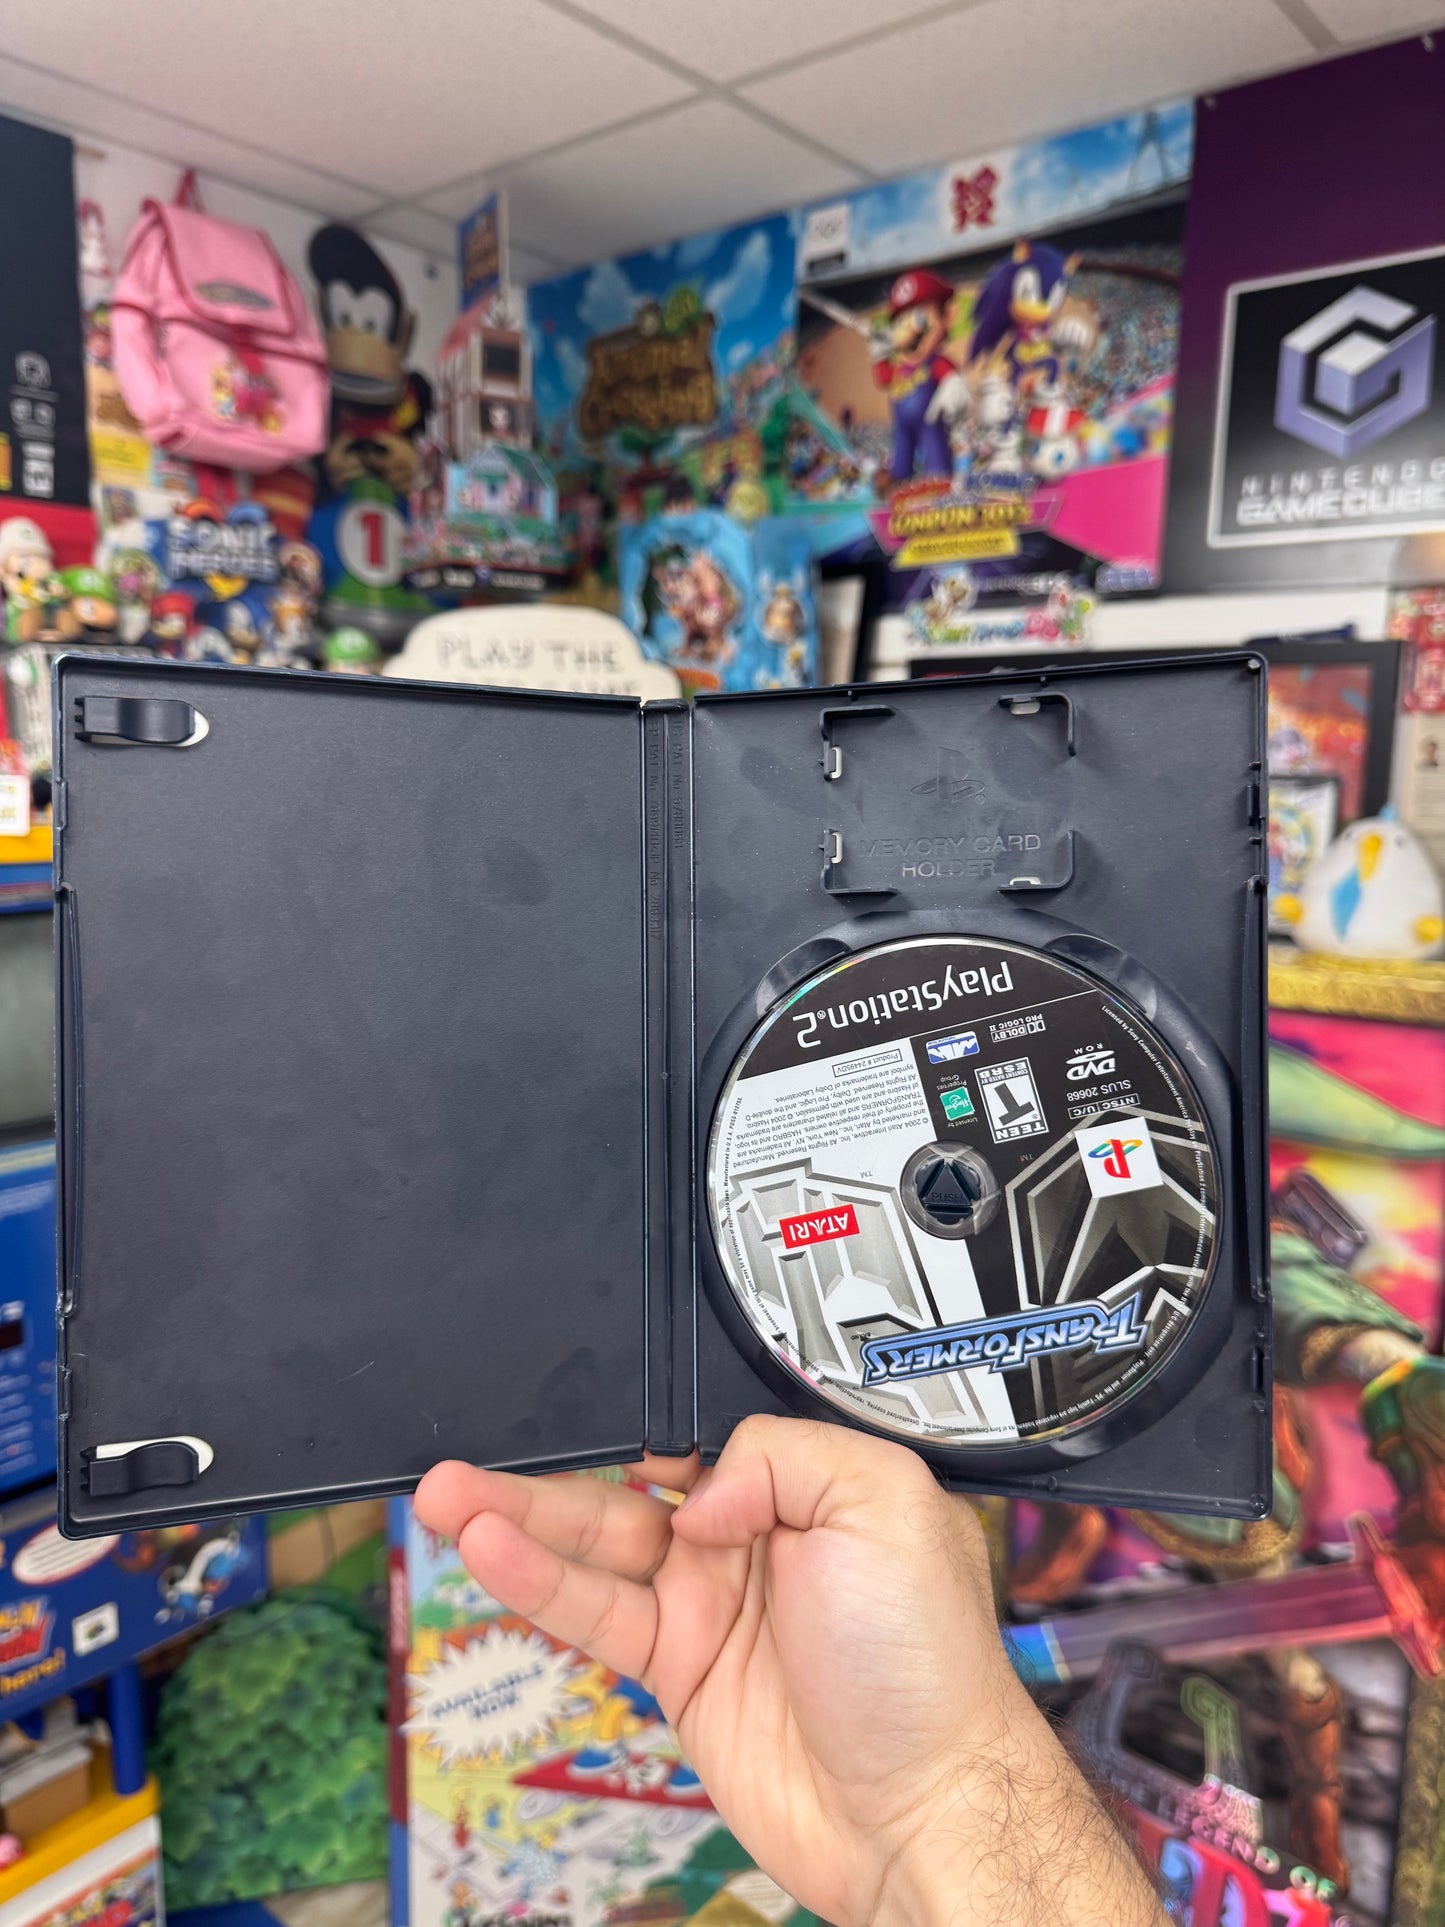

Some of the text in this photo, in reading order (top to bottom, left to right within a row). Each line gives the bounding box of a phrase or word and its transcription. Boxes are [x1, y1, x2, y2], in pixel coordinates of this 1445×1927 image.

[1241, 457, 1445, 498] NINTENDO
[1236, 482, 1445, 526] GAMECUBE
[361, 511, 383, 568] 1
[436, 631, 619, 672] PLAY THE
[859, 833, 1041, 858] MEMORY CARD
[902, 858, 996, 878] HOLDER
[1024, 1012, 1042, 1023] PRO
[1101, 1004, 1124, 1024] Licensed
[997, 1017, 1024, 1029] LOGIC
[992, 1025, 1025, 1040] DOLBY
[1126, 1027, 1140, 1041] Sony
[1073, 1042, 1103, 1054] ROM
[1136, 1038, 1158, 1062] Computer
[872, 1052, 898, 1064] Product
[836, 1060, 866, 1073] 24495DV
[978, 1061, 1026, 1078] ESRB
[1066, 1061, 1115, 1081] DVD
[906, 1073, 916, 1081] All
[939, 1073, 959, 1083] Group
[987, 1073, 1004, 1082] RATED
[1004, 1068, 1027, 1078] CONTENT
[1155, 1061, 1179, 1096] Entertainment
[774, 1063, 914, 1103] symbol are trademarks of Dolby Laboratories.
[884, 1075, 907, 1085] Rights
[936, 1078, 966, 1091] Properties
[851, 1080, 885, 1094] Reserved.
[886, 1083, 911, 1094] Hasbro
[1066, 1079, 1131, 1101] SLUS 20668
[817, 1094, 830, 1102] Pro
[829, 1089, 851, 1098] Dolby,
[873, 1089, 886, 1099] and
[797, 1097, 817, 1107] Logic,
[829, 1100, 843, 1108] with
[844, 1096, 860, 1106] used
[860, 1090, 922, 1110] TRANSFORMERS
[943, 1097, 970, 1111] Hasbro
[993, 1082, 1035, 1126] T
[1072, 1096, 1134, 1115] NTSC U/C
[773, 1105, 784, 1113] the
[784, 1102, 797, 1111] and
[794, 1102, 829, 1116] permission.
[838, 1108, 846, 1116] all
[846, 1105, 860, 1114] and
[876, 1108, 884, 1116] of
[884, 1100, 911, 1113] property
[912, 1107, 926, 1117] and
[770, 1114, 786, 1123] 2004
[815, 1110, 838, 1121] related
[827, 1113, 861, 1127] respective
[861, 1110, 876, 1119] their
[881, 1111, 912, 1124] marketed
[782, 1116, 815, 1129] characters
[802, 1122, 827, 1132] owners.
[853, 1120, 871, 1130] Atari,
[872, 1118, 881, 1126] by
[887, 1122, 903, 1132] Atari
[904, 1118, 921, 1128] 2004
[953, 1116, 978, 1126] Licensed
[735, 1127, 770, 1140] trademarks
[771, 1128, 802, 1141] HASBRO
[823, 1128, 838, 1137] New
[851, 1126, 887, 1139] Interactive,
[995, 1121, 1044, 1139] TEEN
[758, 1135, 771, 1144] and
[792, 1136, 805, 1145] NY.
[805, 1132, 823, 1141] York,
[828, 1137, 837, 1146] All
[838, 1135, 851, 1143] Inc.
[734, 1140, 750, 1149] logo,
[747, 1142, 783, 1155] trademarks
[782, 1139, 791, 1147] All
[807, 1139, 828, 1149] Rights
[775, 1145, 807, 1158] Reserved.
[732, 1152, 775, 1168] Manufactured
[1194, 1150, 1205, 1181] PlayStation
[858, 1169, 872, 1178] TM
[788, 1212, 848, 1241] ATARI
[760, 1308, 779, 1331] broadcast
[866, 1304, 1139, 1383] TRANSFORMERS
